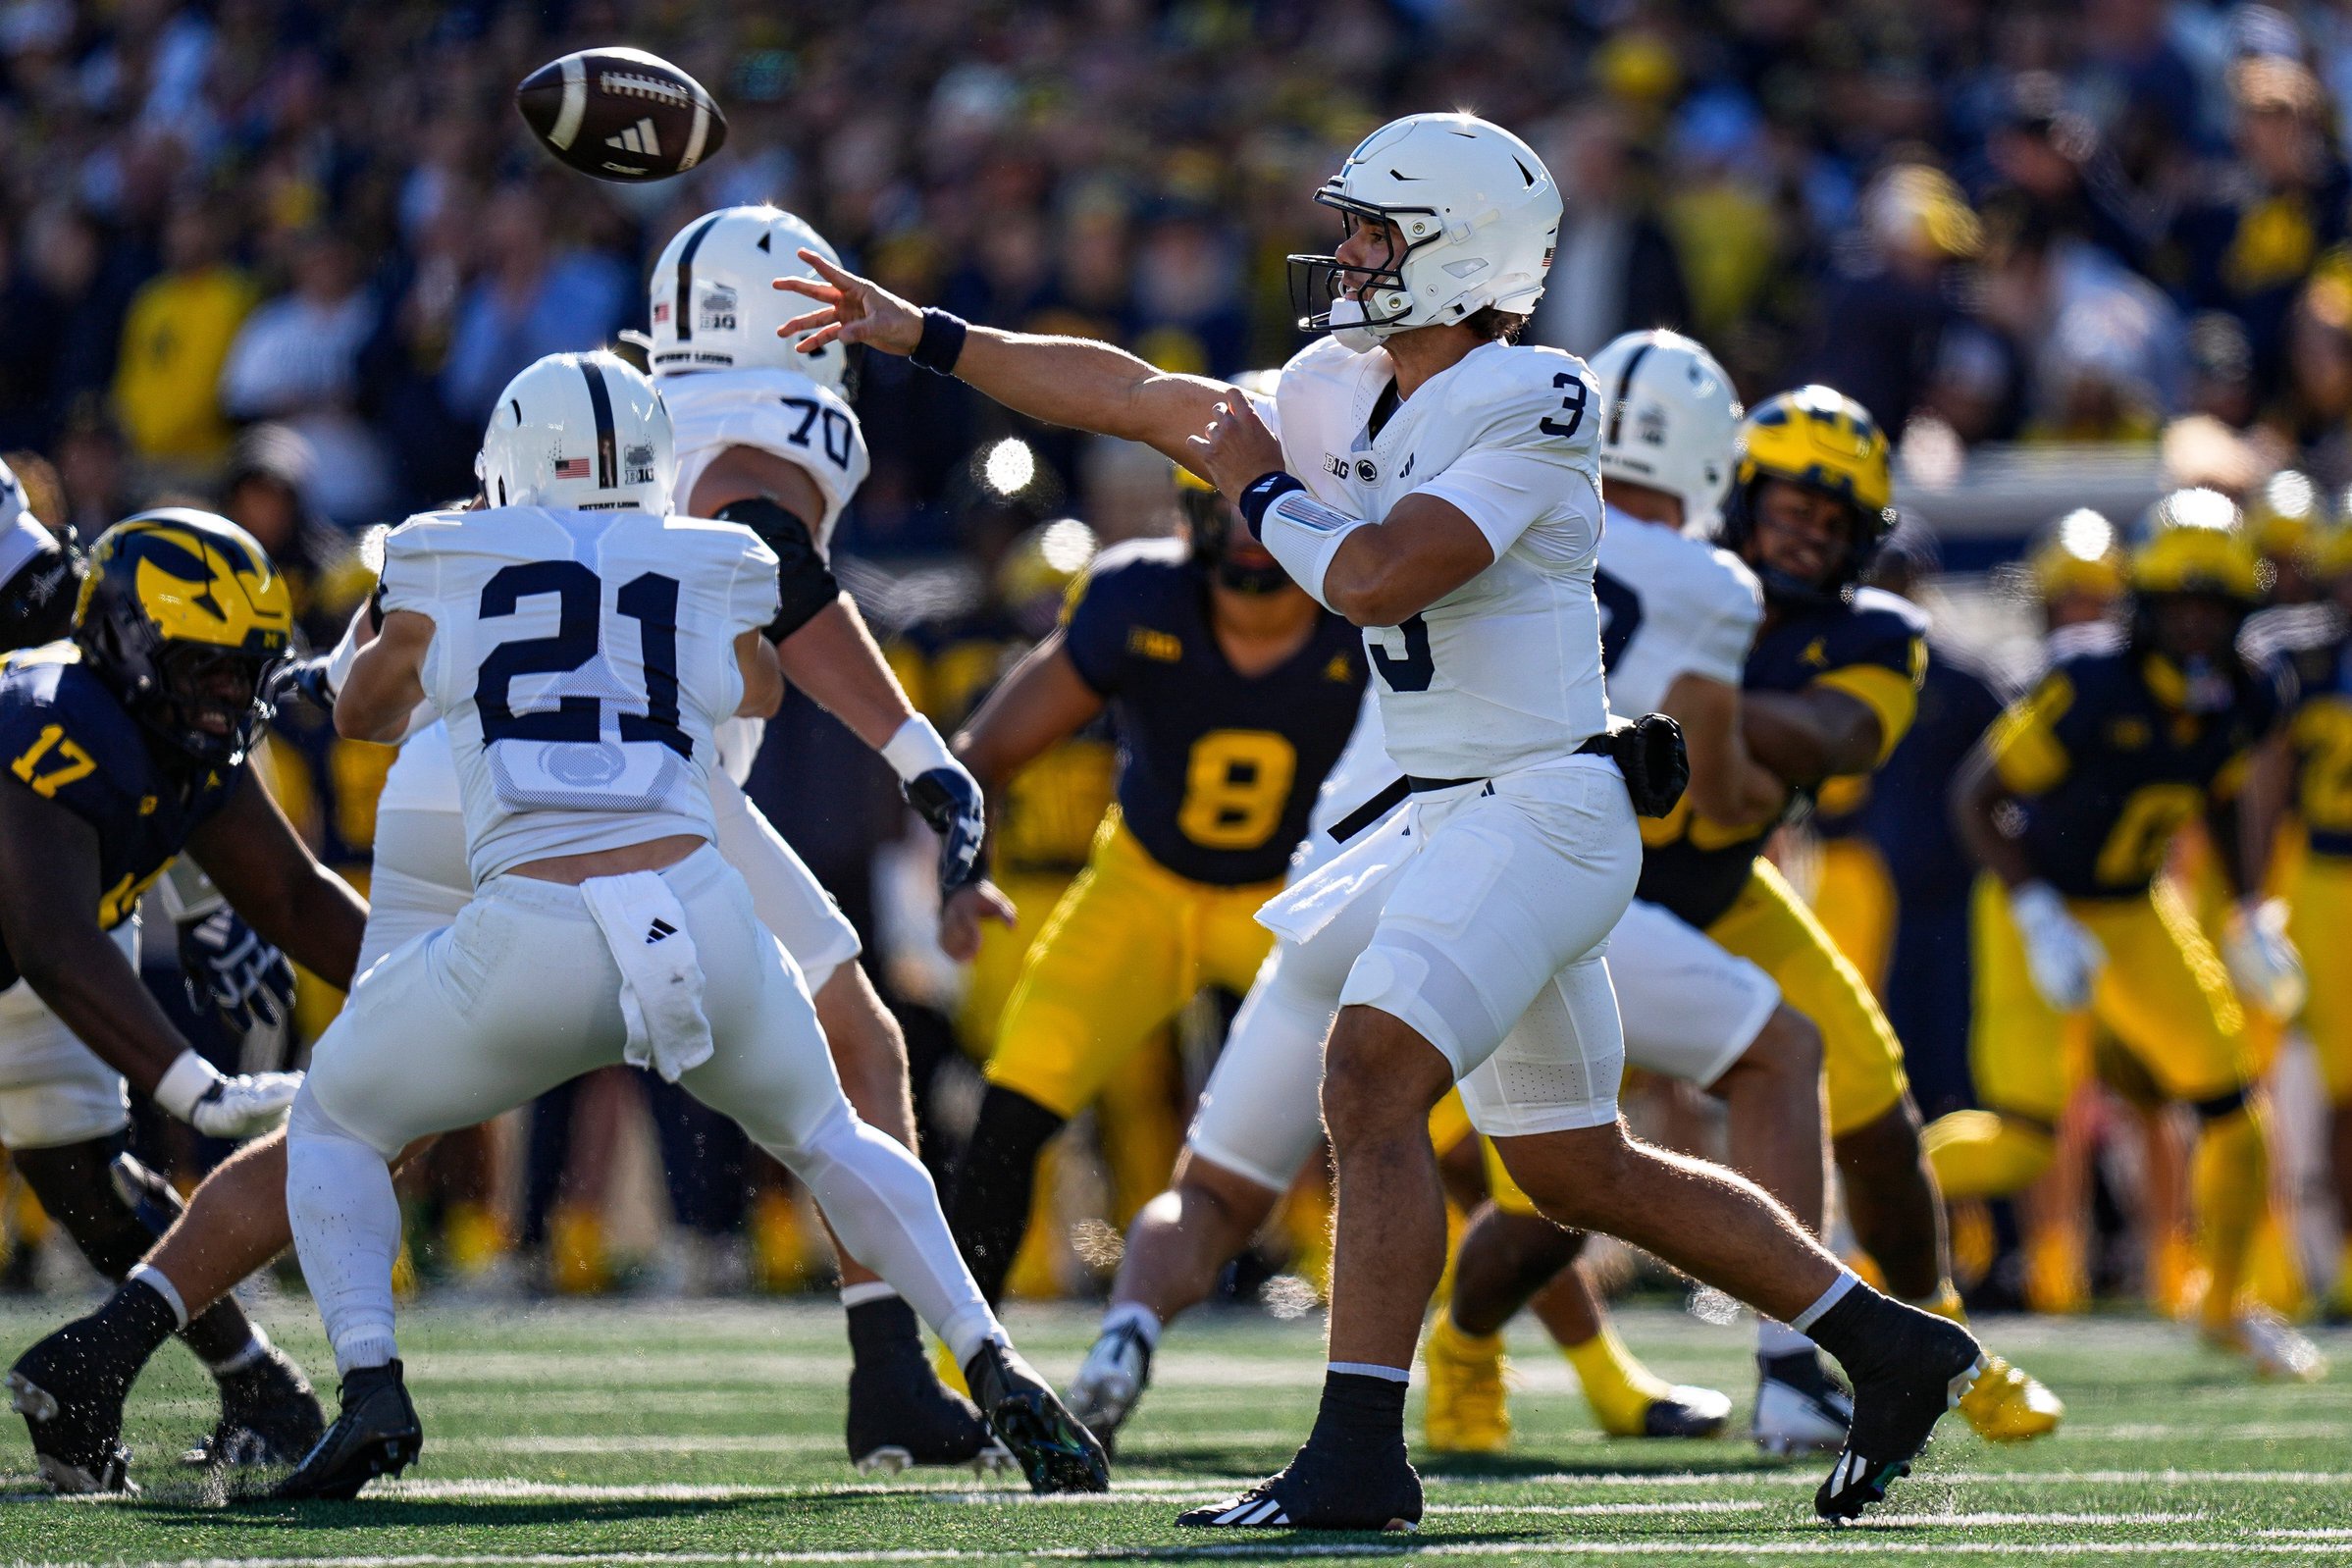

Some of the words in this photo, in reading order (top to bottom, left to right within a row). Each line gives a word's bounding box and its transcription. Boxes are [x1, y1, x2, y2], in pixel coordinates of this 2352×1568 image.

[779, 396, 854, 471] 70
[1539, 372, 1588, 439] 3
[473, 559, 695, 762] 21
[11, 723, 97, 800] 17
[1177, 728, 1297, 852] 8
